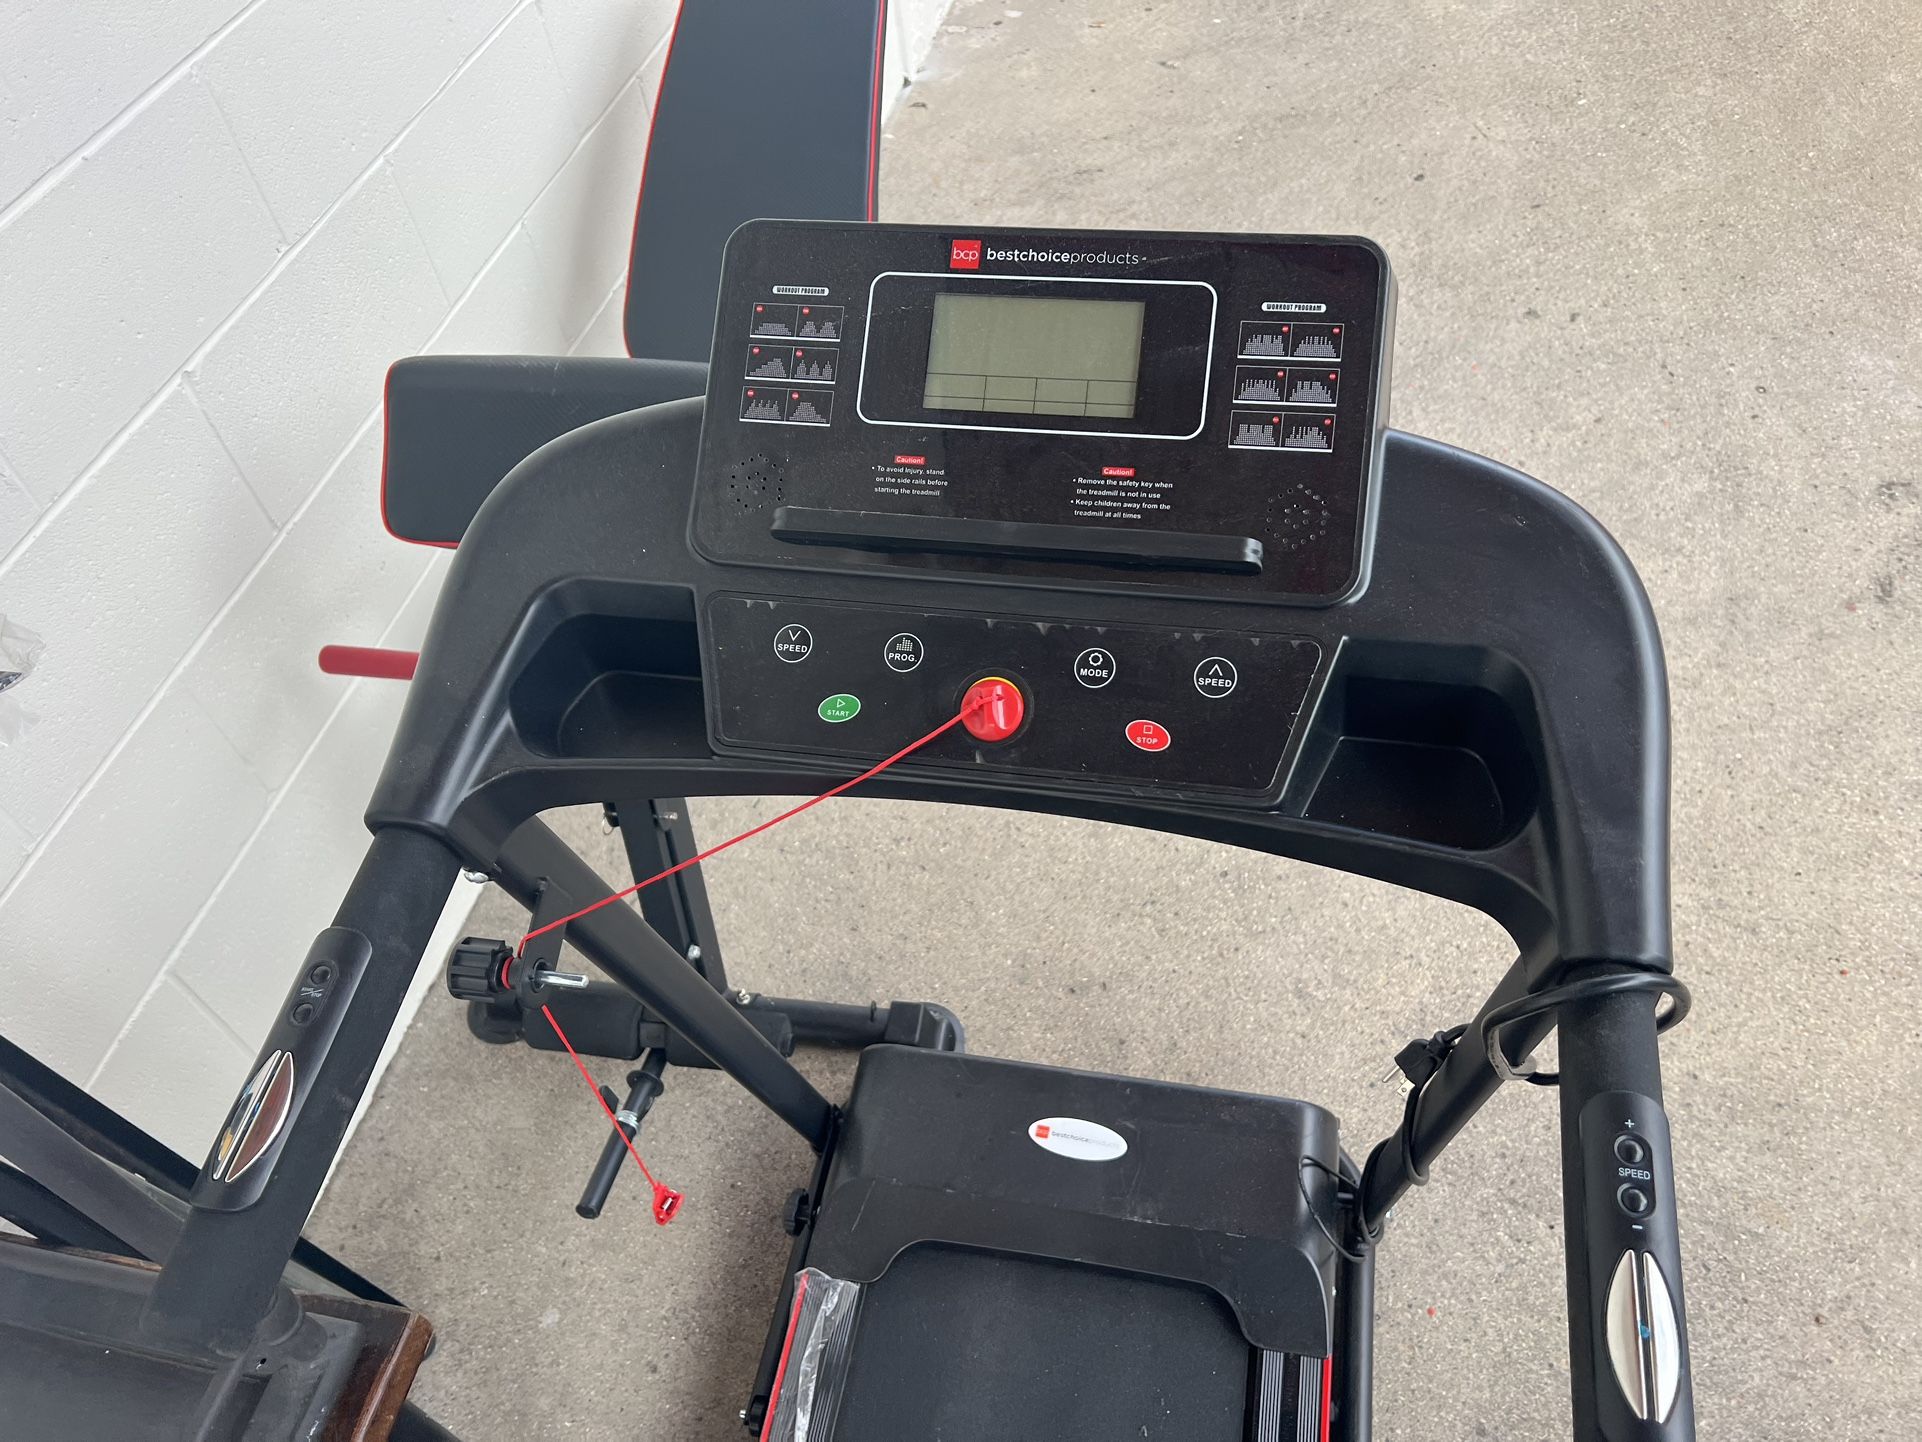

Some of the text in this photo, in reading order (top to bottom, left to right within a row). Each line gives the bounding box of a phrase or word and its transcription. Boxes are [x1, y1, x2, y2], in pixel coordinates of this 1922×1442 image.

[953, 247, 1140, 265] bcp bestchoiceproducts
[776, 286, 826, 295] WORKOUT PROGRAM
[1266, 303, 1293, 311] WORKOUT
[896, 456, 924, 464] Caution!
[1103, 468, 1133, 476] Caution!
[1077, 477, 1105, 485] Remove
[1119, 480, 1139, 488] safety
[1141, 481, 1153, 489] key
[912, 488, 940, 496] treadmill
[1088, 488, 1118, 496] treadmill
[1075, 499, 1093, 507] Keep
[1094, 499, 1121, 507] children
[1123, 502, 1141, 510] away
[1074, 509, 1104, 517] treadmill
[777, 643, 808, 653] SPEED
[888, 652, 918, 662] PROG.
[1080, 668, 1109, 678] MODE
[1198, 677, 1232, 688] SPEED
[826, 709, 850, 717] START
[1135, 736, 1159, 745] STOP
[1051, 1131, 1121, 1149] bestchoice
[1618, 1167, 1651, 1180] SPEED
